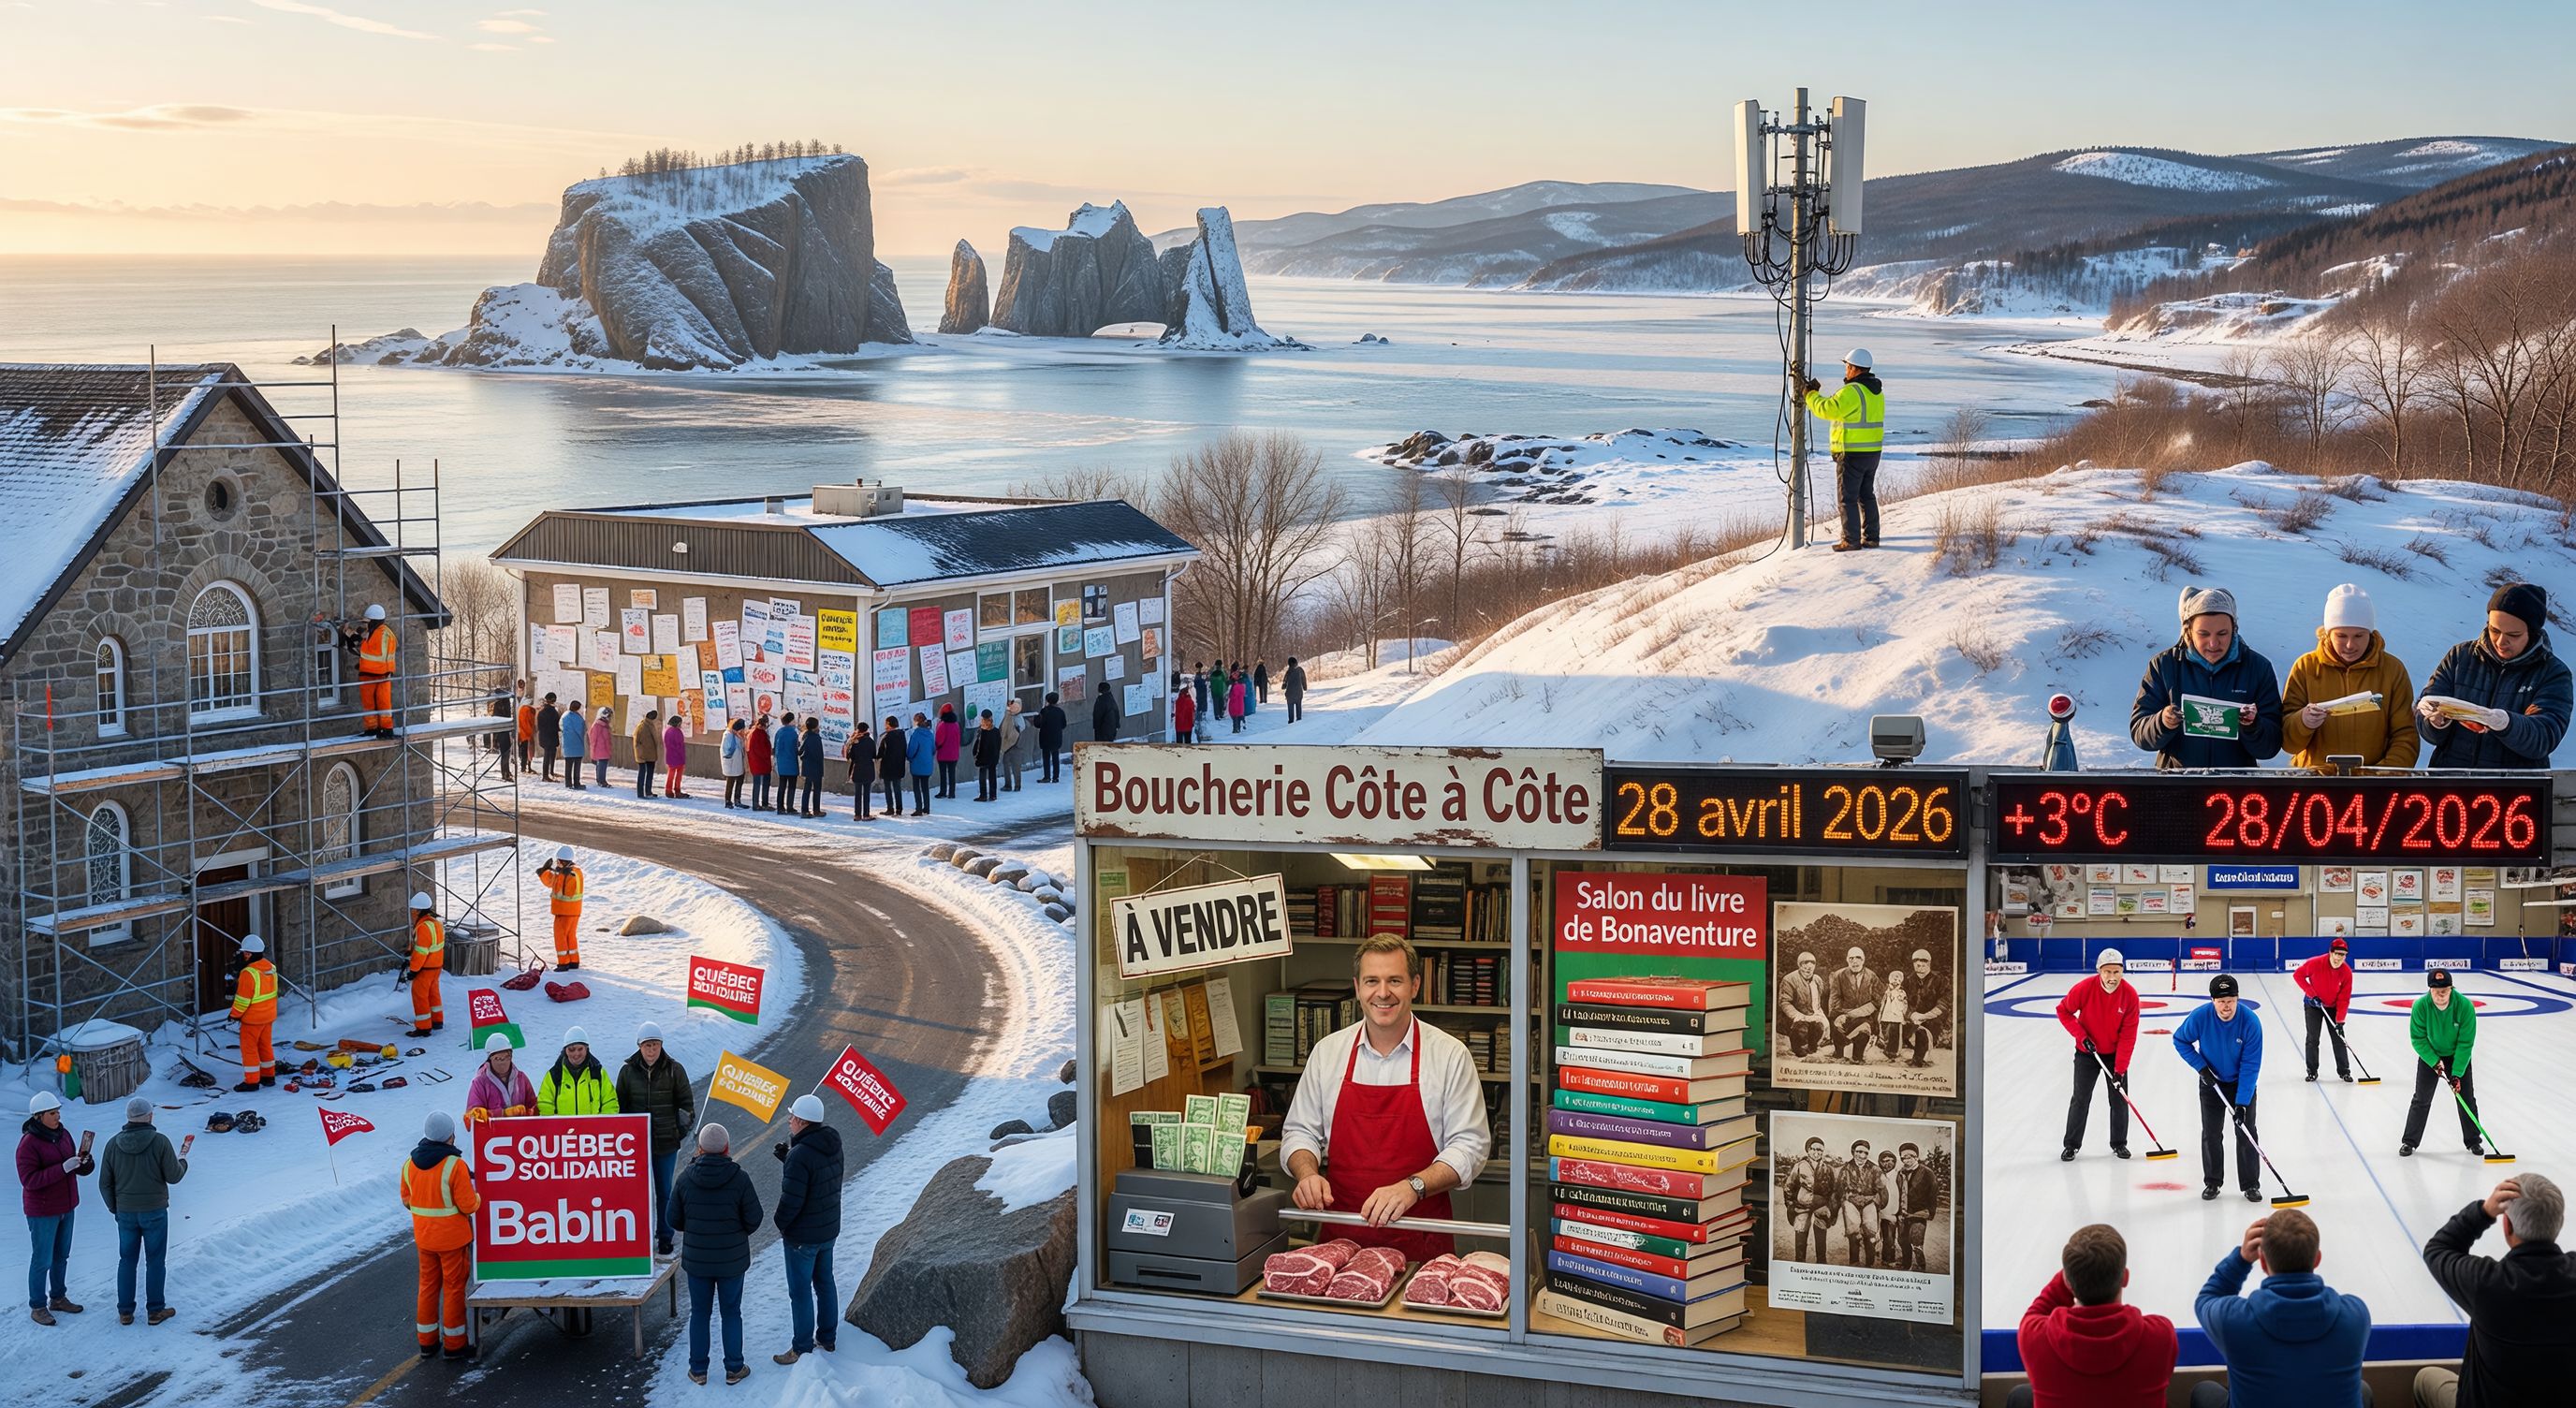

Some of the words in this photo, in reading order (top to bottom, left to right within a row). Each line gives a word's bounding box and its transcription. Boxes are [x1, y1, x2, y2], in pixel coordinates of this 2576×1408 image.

[1094, 761, 1310, 818] Boucherie
[1326, 764, 1427, 821] Côte
[1442, 765, 1467, 822] à
[1483, 767, 1588, 825] Côte
[1617, 782, 1679, 836] 28
[1698, 784, 1801, 839] avril
[1823, 785, 1953, 843] 2026
[2005, 792, 2128, 845] +3°C
[2205, 793, 2535, 851] 28/04/2026
[1577, 882, 1644, 910] Salon
[1651, 883, 1682, 912] du
[1691, 883, 1745, 914] livre
[1126, 902, 1149, 964] À
[1149, 890, 1283, 959] VENDRE
[1563, 914, 1593, 942] de
[1602, 916, 1757, 948] Bonaventure
[694, 966, 757, 992] QUÉBEC
[518, 1128, 636, 1160] QUÉBEC
[519, 1160, 637, 1181] SOLIDAIRE
[490, 1197, 637, 1245] Babin
